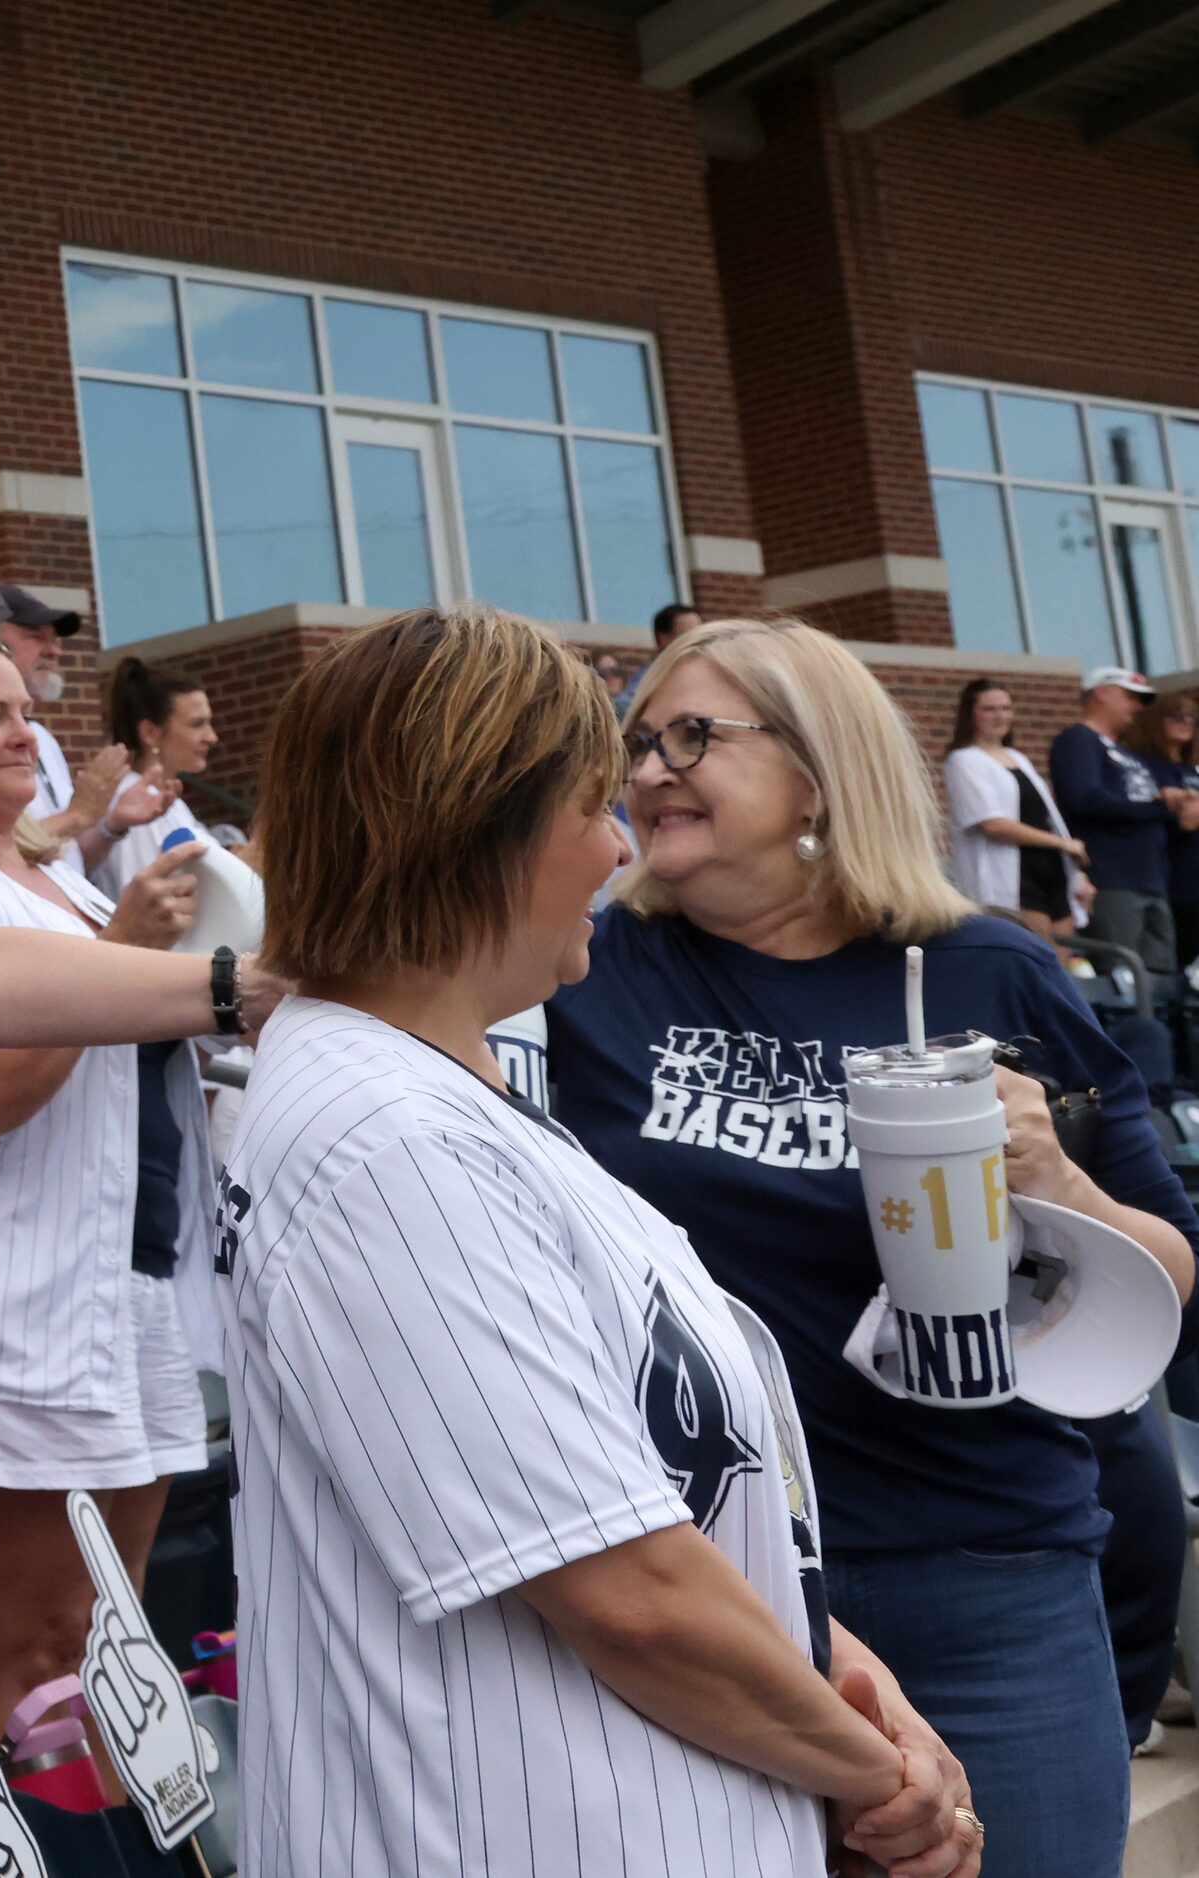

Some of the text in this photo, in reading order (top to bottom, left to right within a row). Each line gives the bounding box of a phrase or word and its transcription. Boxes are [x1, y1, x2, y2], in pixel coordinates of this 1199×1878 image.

[651, 1025, 868, 1103] KELL
[639, 1078, 861, 1170] BASEB
[880, 1154, 1010, 1250] #1 F
[164, 1783, 199, 1821] INDIANS
